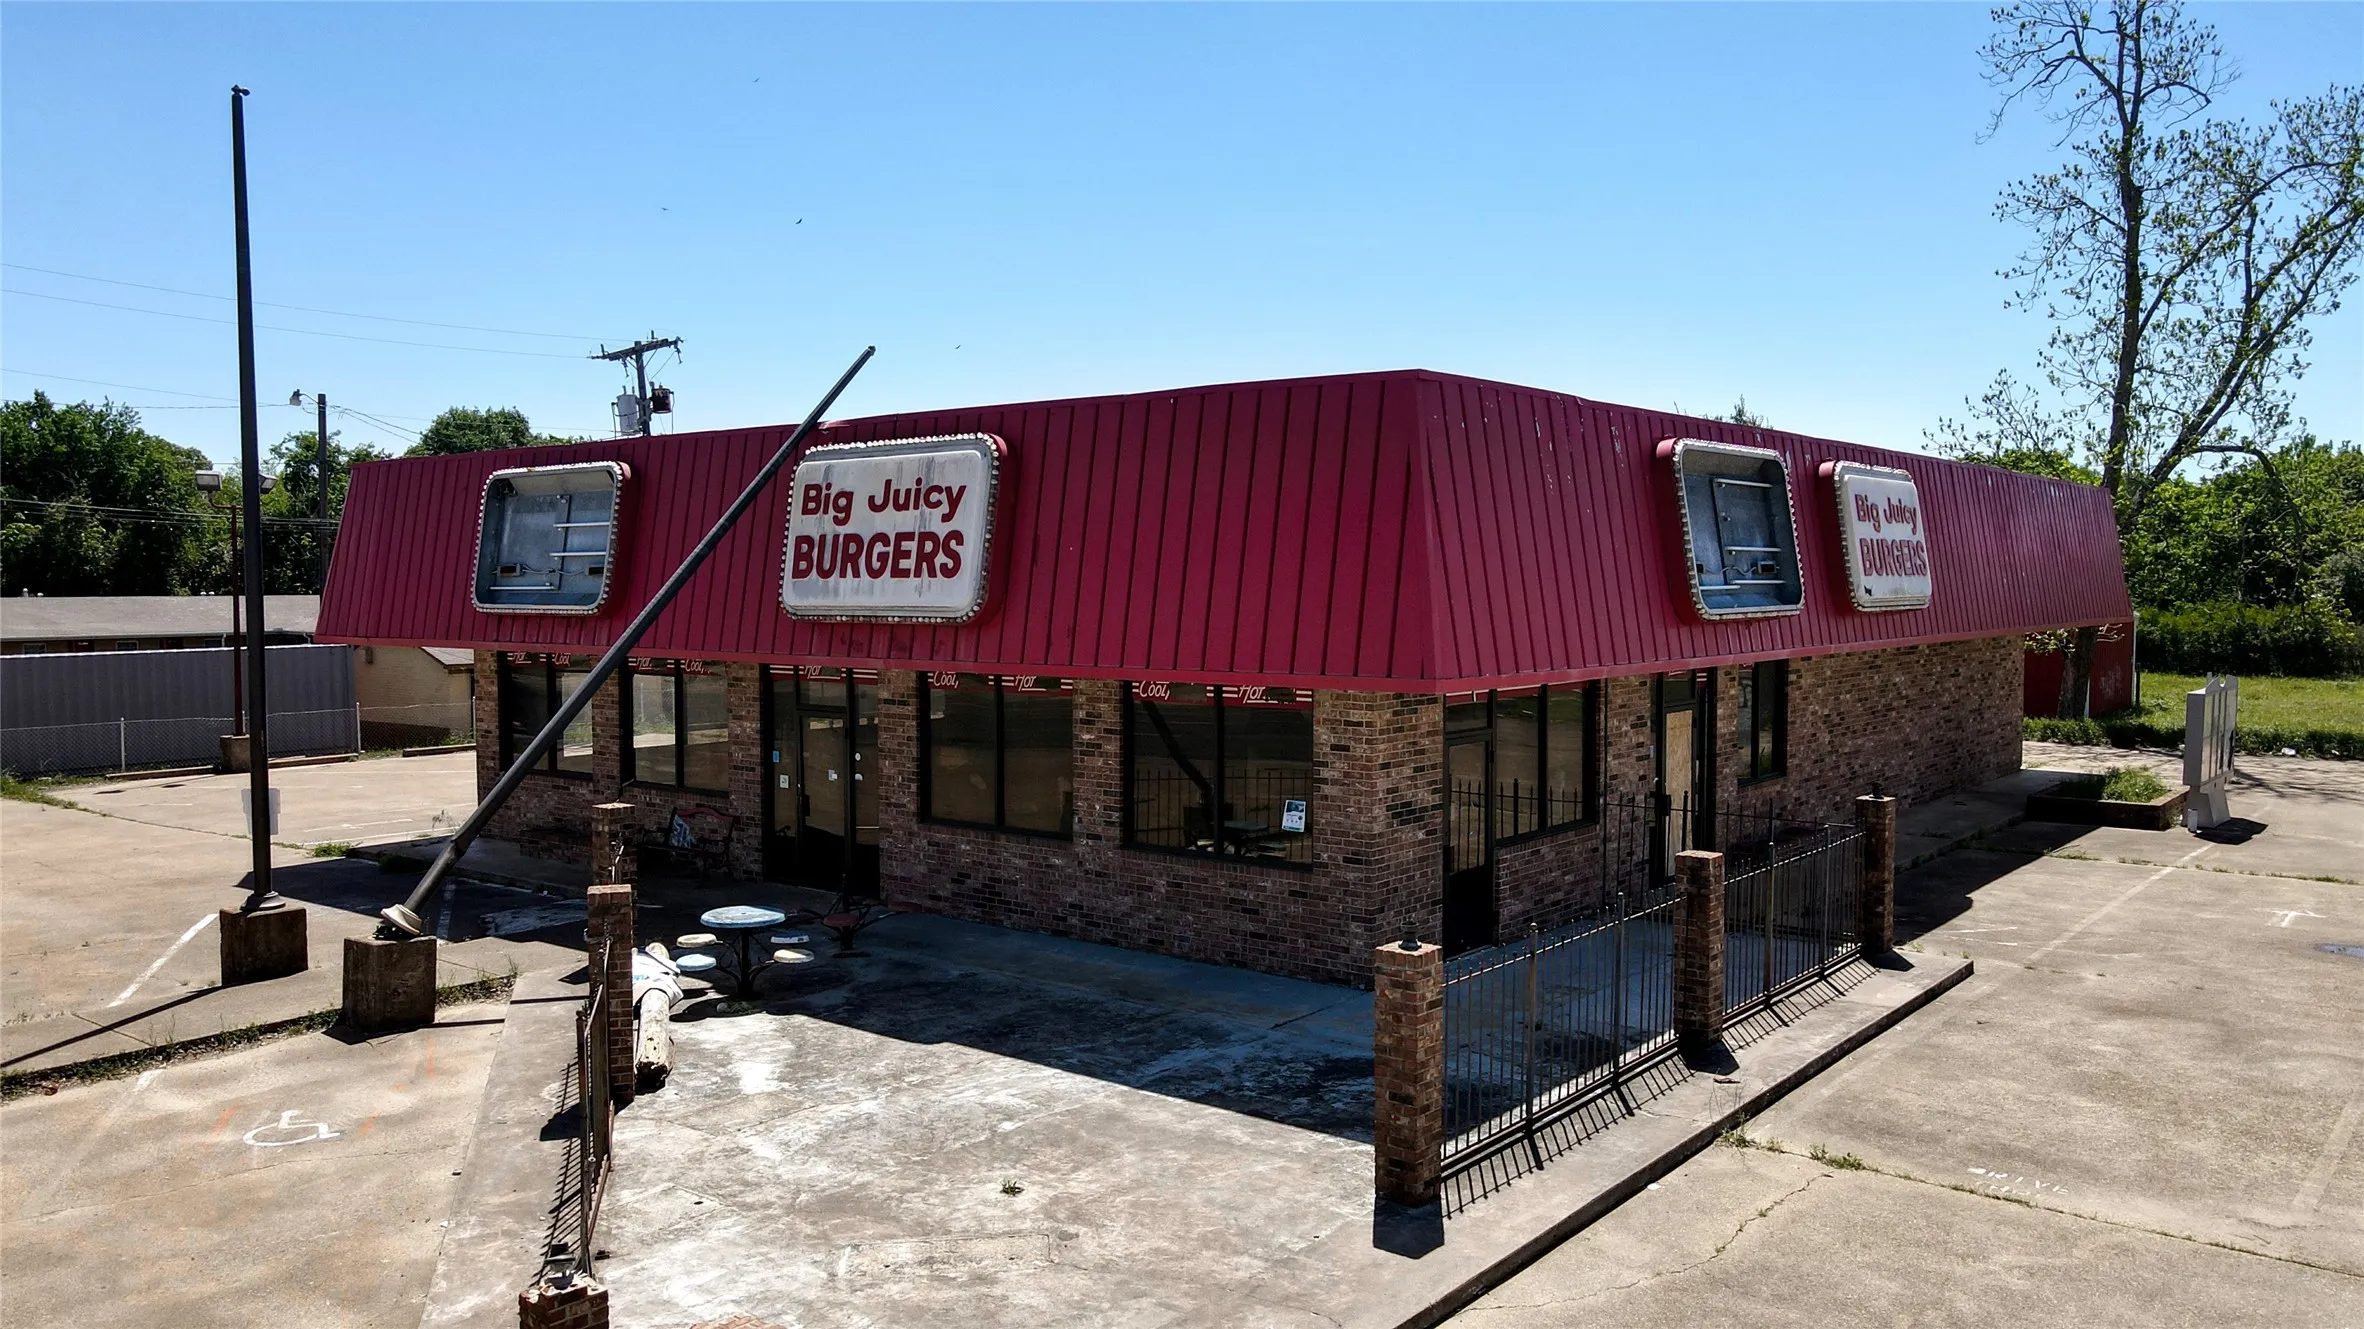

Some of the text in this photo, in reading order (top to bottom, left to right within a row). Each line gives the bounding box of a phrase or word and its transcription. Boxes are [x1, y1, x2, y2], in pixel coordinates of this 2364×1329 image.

[801, 476, 967, 527] Big Juicy
[1854, 493, 1918, 535] Big Juicy
[791, 529, 965, 580] BURGERS
[1859, 537, 1928, 578] BURGERS
